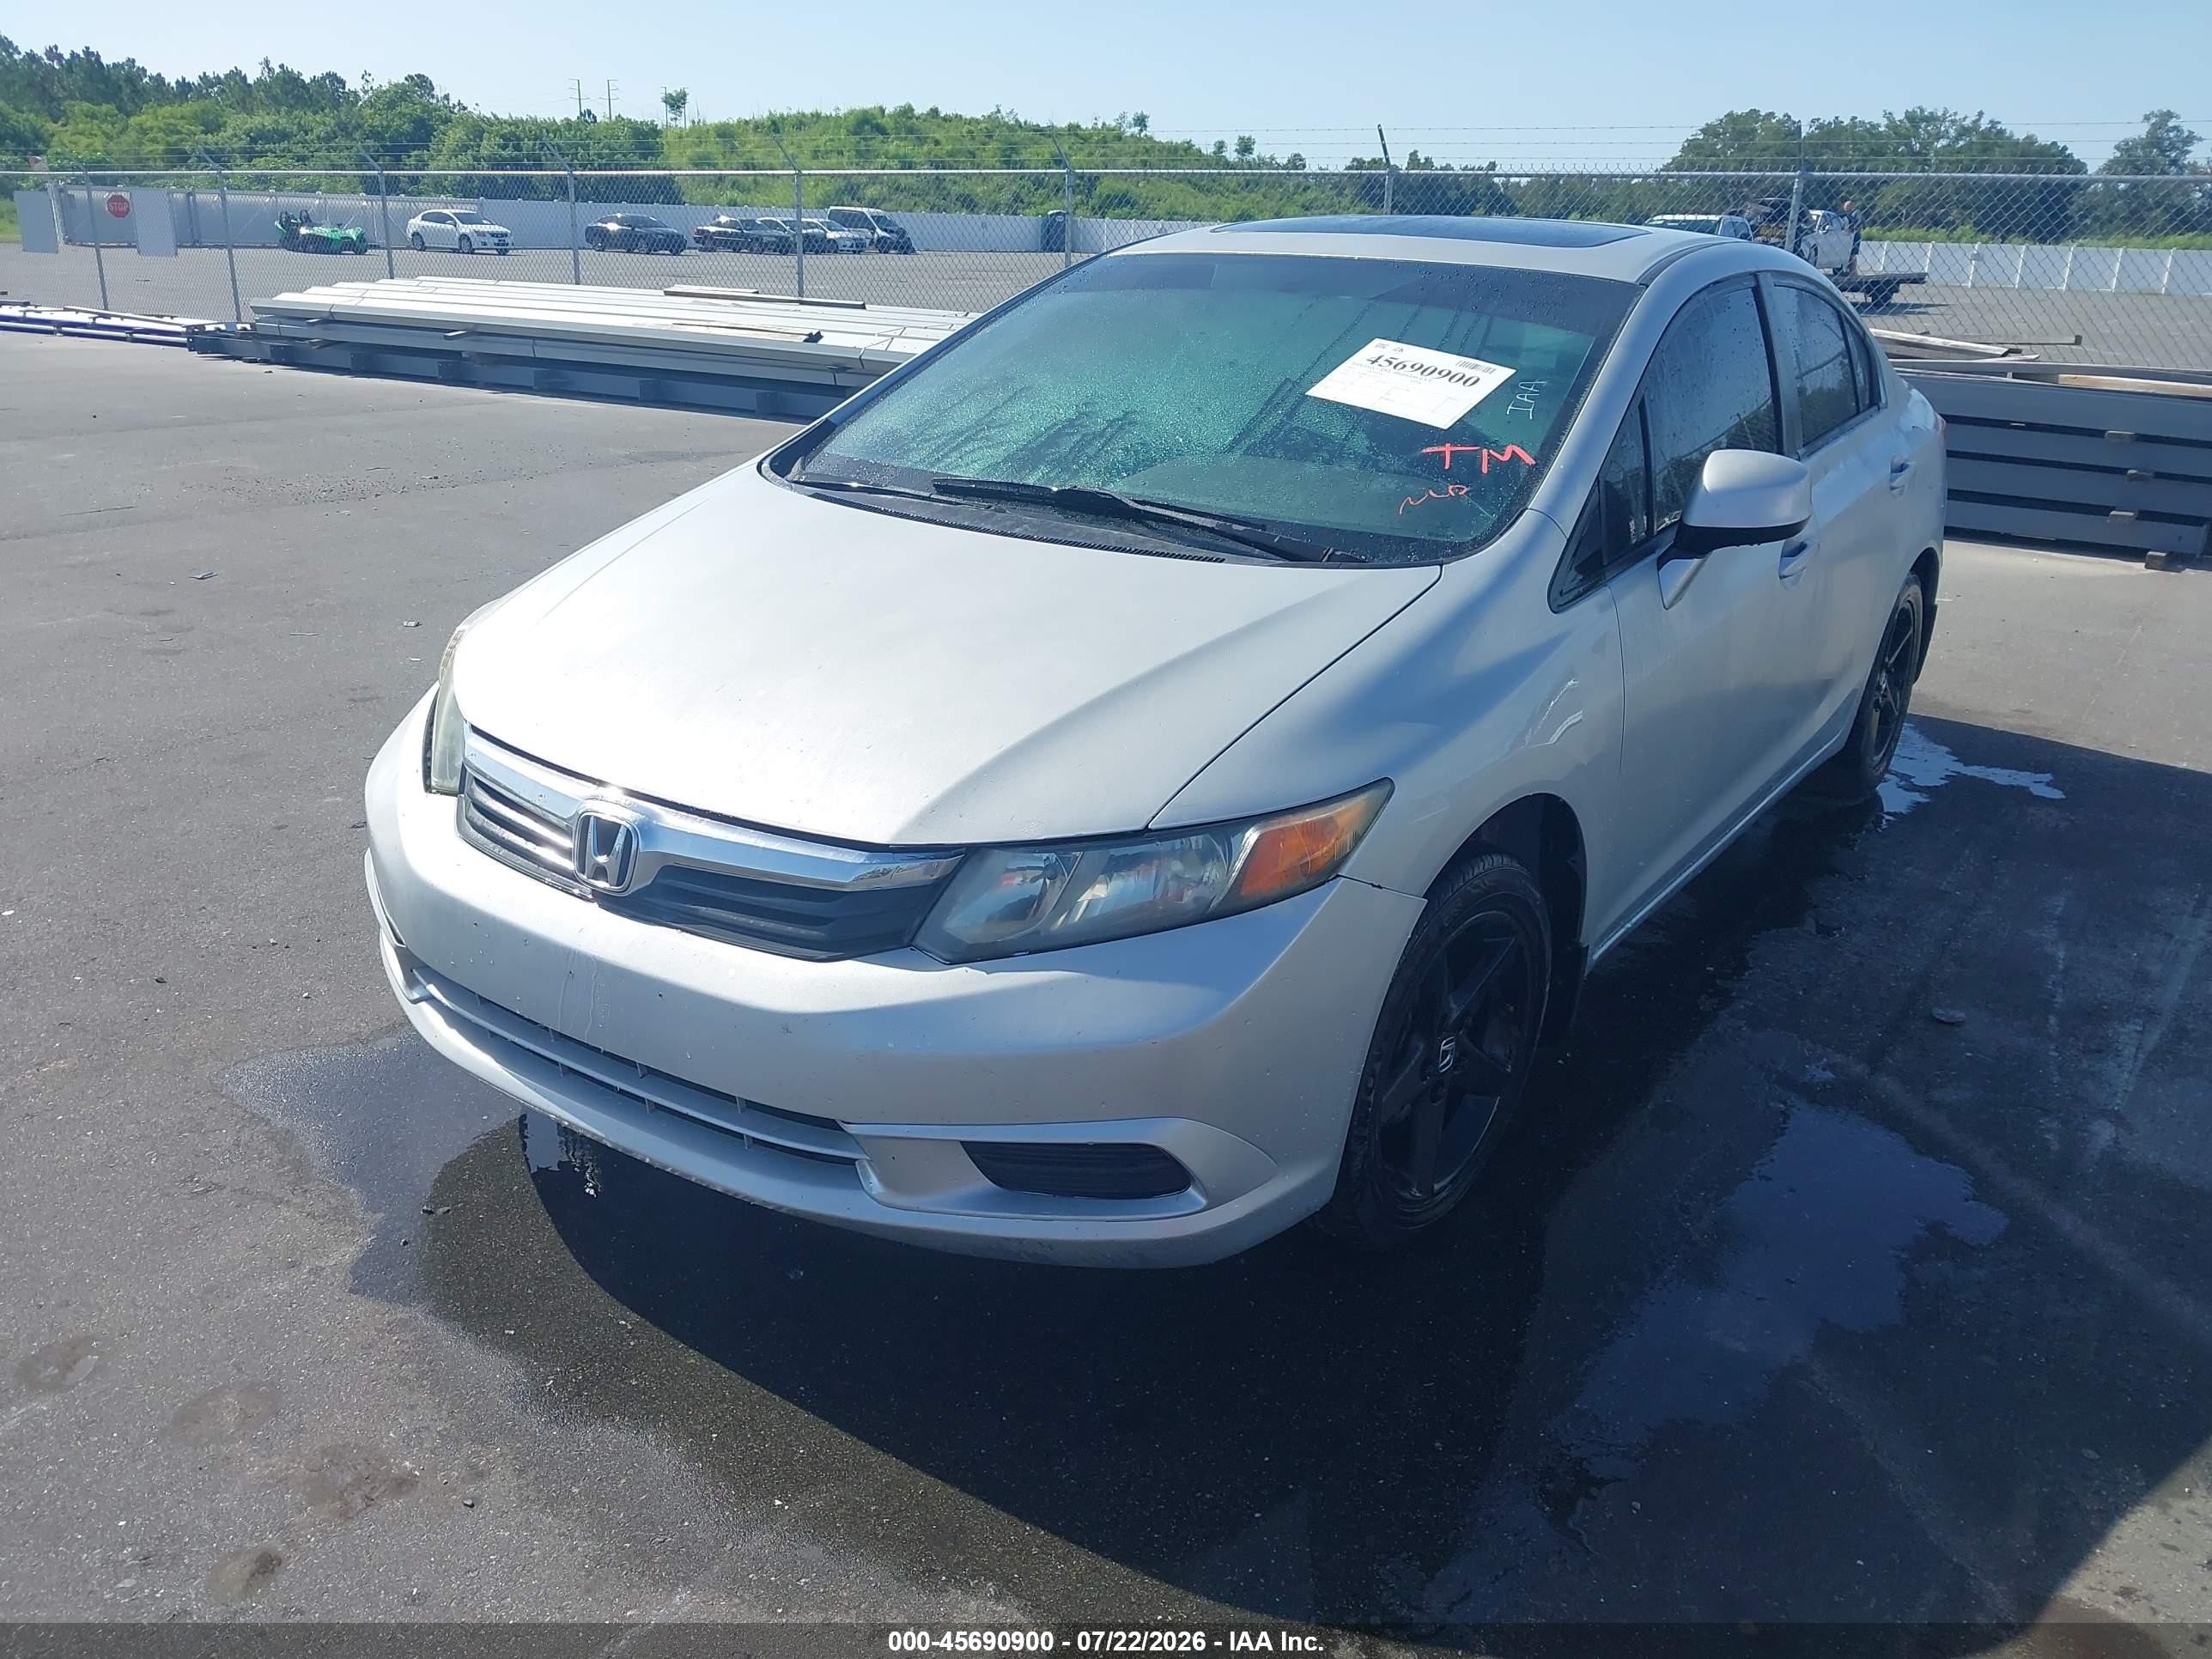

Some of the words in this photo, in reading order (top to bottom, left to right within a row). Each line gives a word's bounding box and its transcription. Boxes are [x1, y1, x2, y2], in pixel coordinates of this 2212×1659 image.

[109, 202, 129, 212] STOP
[1366, 355, 1480, 387] 45690900
[1506, 380, 1547, 419] IAA
[1421, 442, 1535, 473] TM
